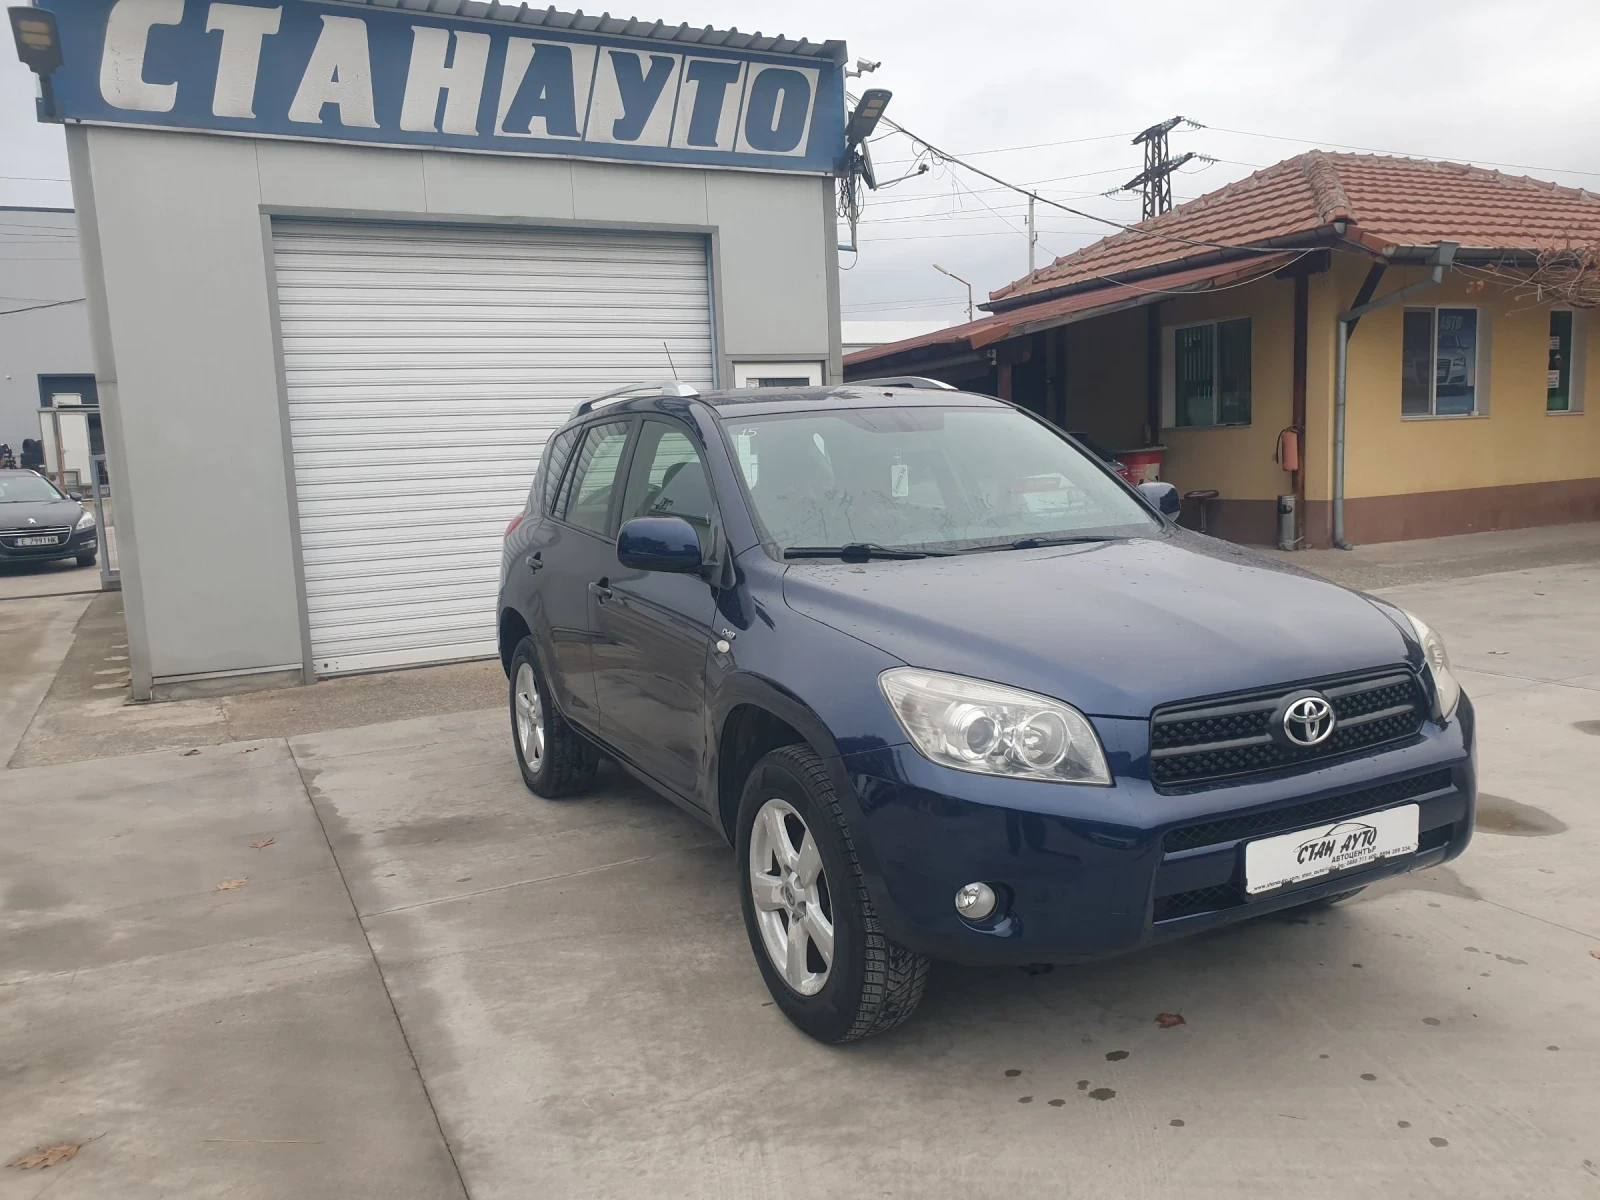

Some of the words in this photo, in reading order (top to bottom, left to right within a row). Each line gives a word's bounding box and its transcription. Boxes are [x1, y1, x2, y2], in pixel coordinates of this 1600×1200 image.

[739, 428, 759, 438] 15
[1297, 840, 1336, 865] СТАН
[1340, 827, 1377, 853] АУТО
[1332, 846, 1377, 863] АВТОЦЕНТЪР
